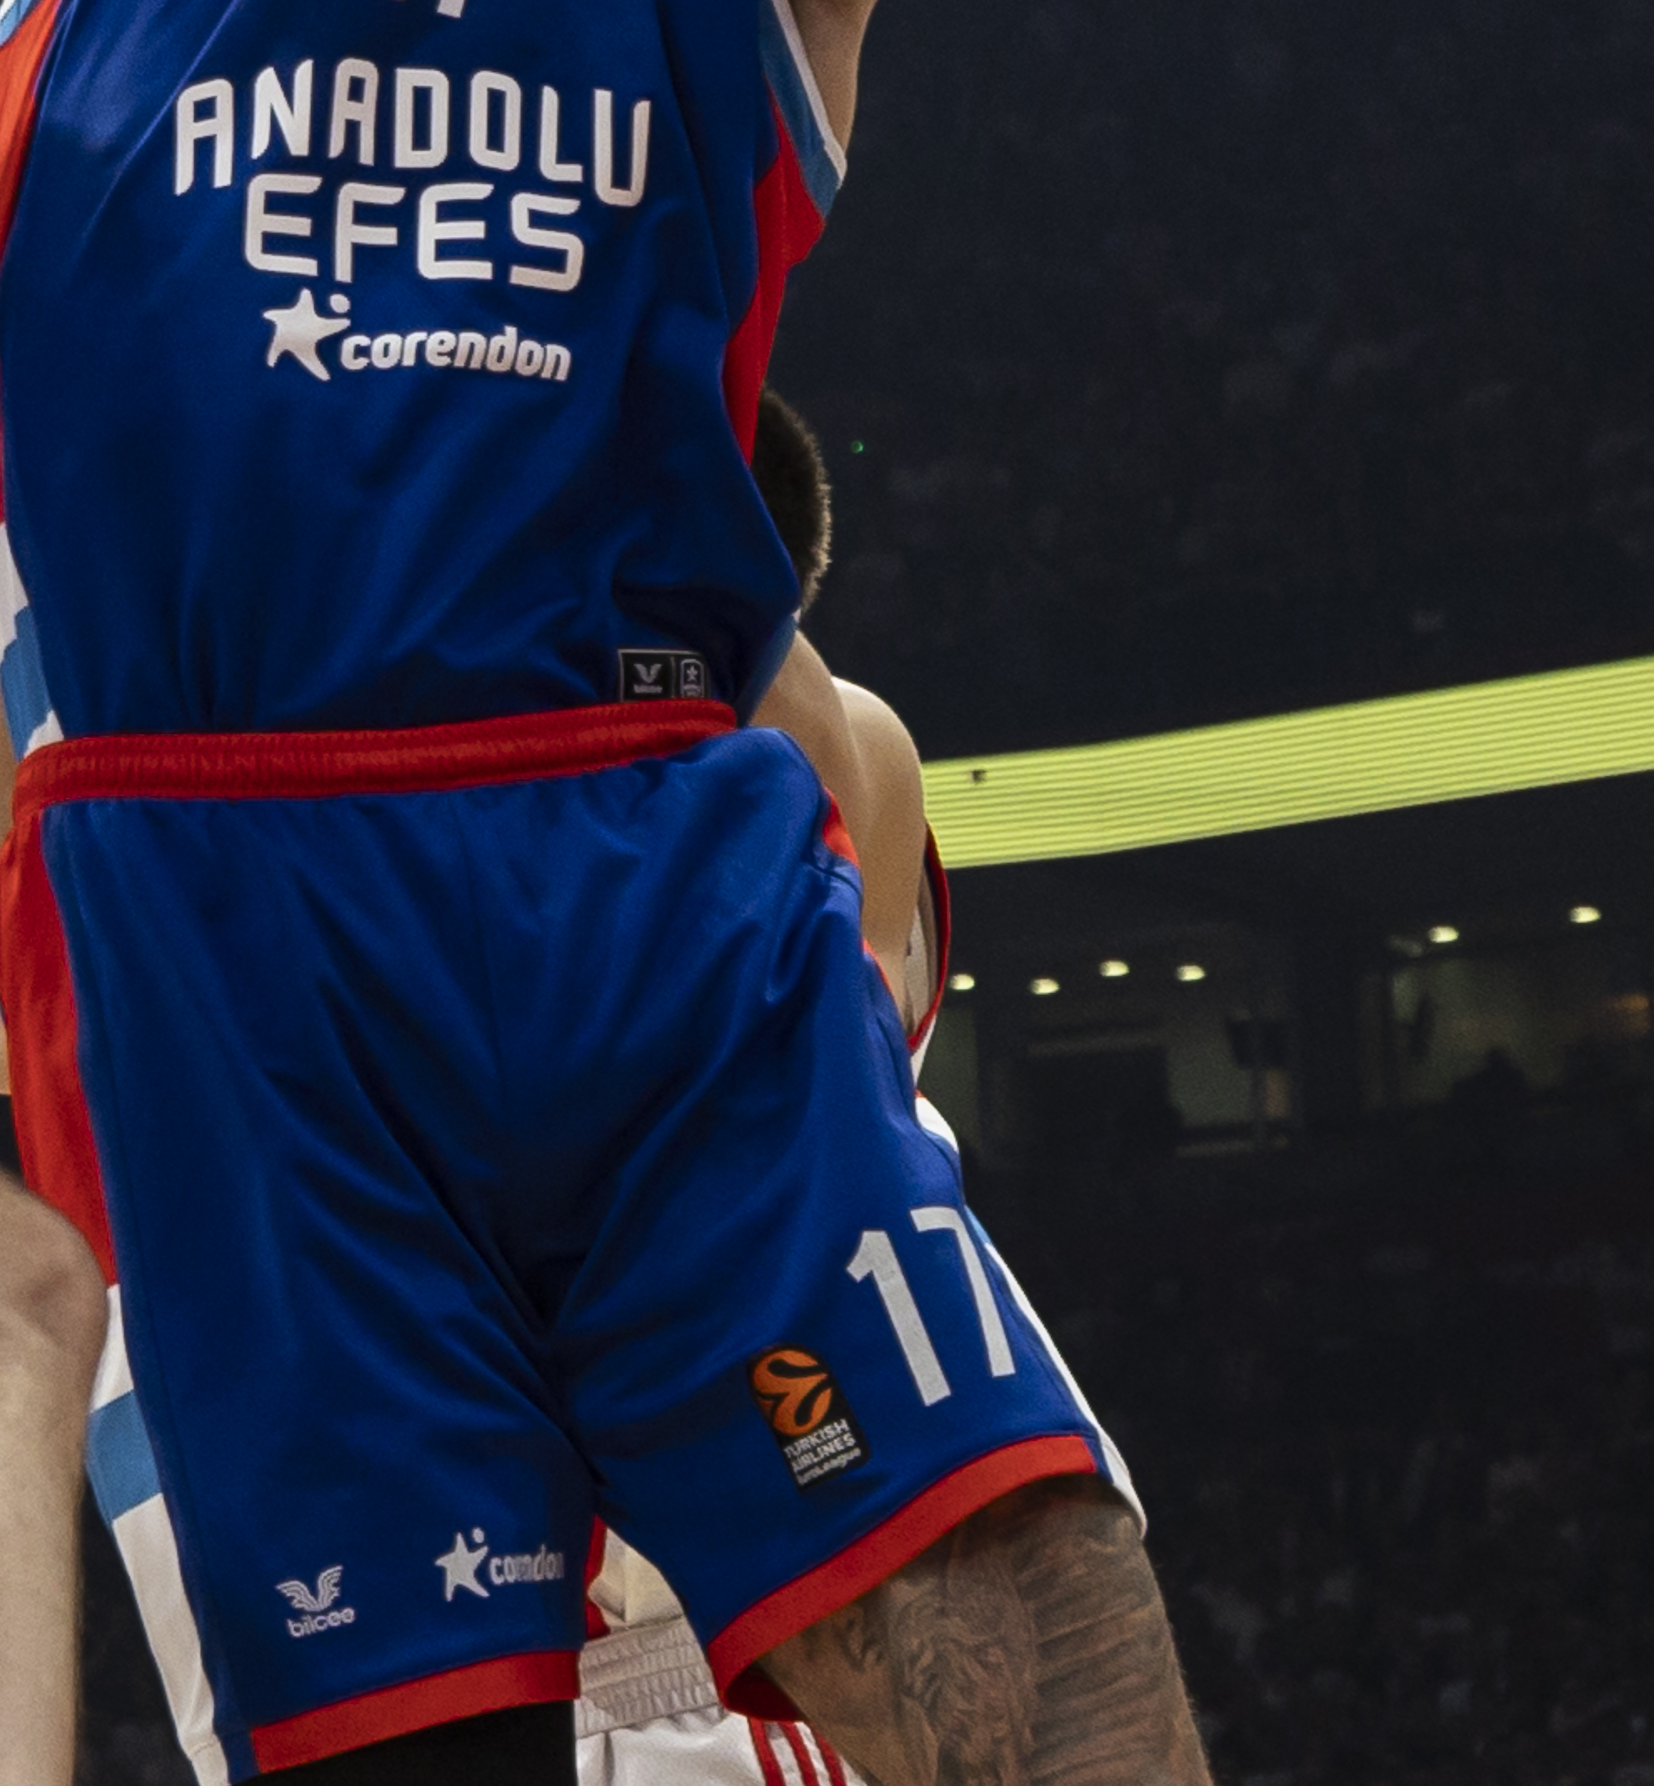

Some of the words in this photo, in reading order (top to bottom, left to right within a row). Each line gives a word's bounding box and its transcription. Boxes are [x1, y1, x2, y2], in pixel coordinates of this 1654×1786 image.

[174, 58, 651, 207] ANADOLU
[245, 174, 584, 291] EFES
[340, 324, 571, 382] corendon
[846, 1206, 1017, 1407] 17
[287, 1606, 357, 1639] bilcee
